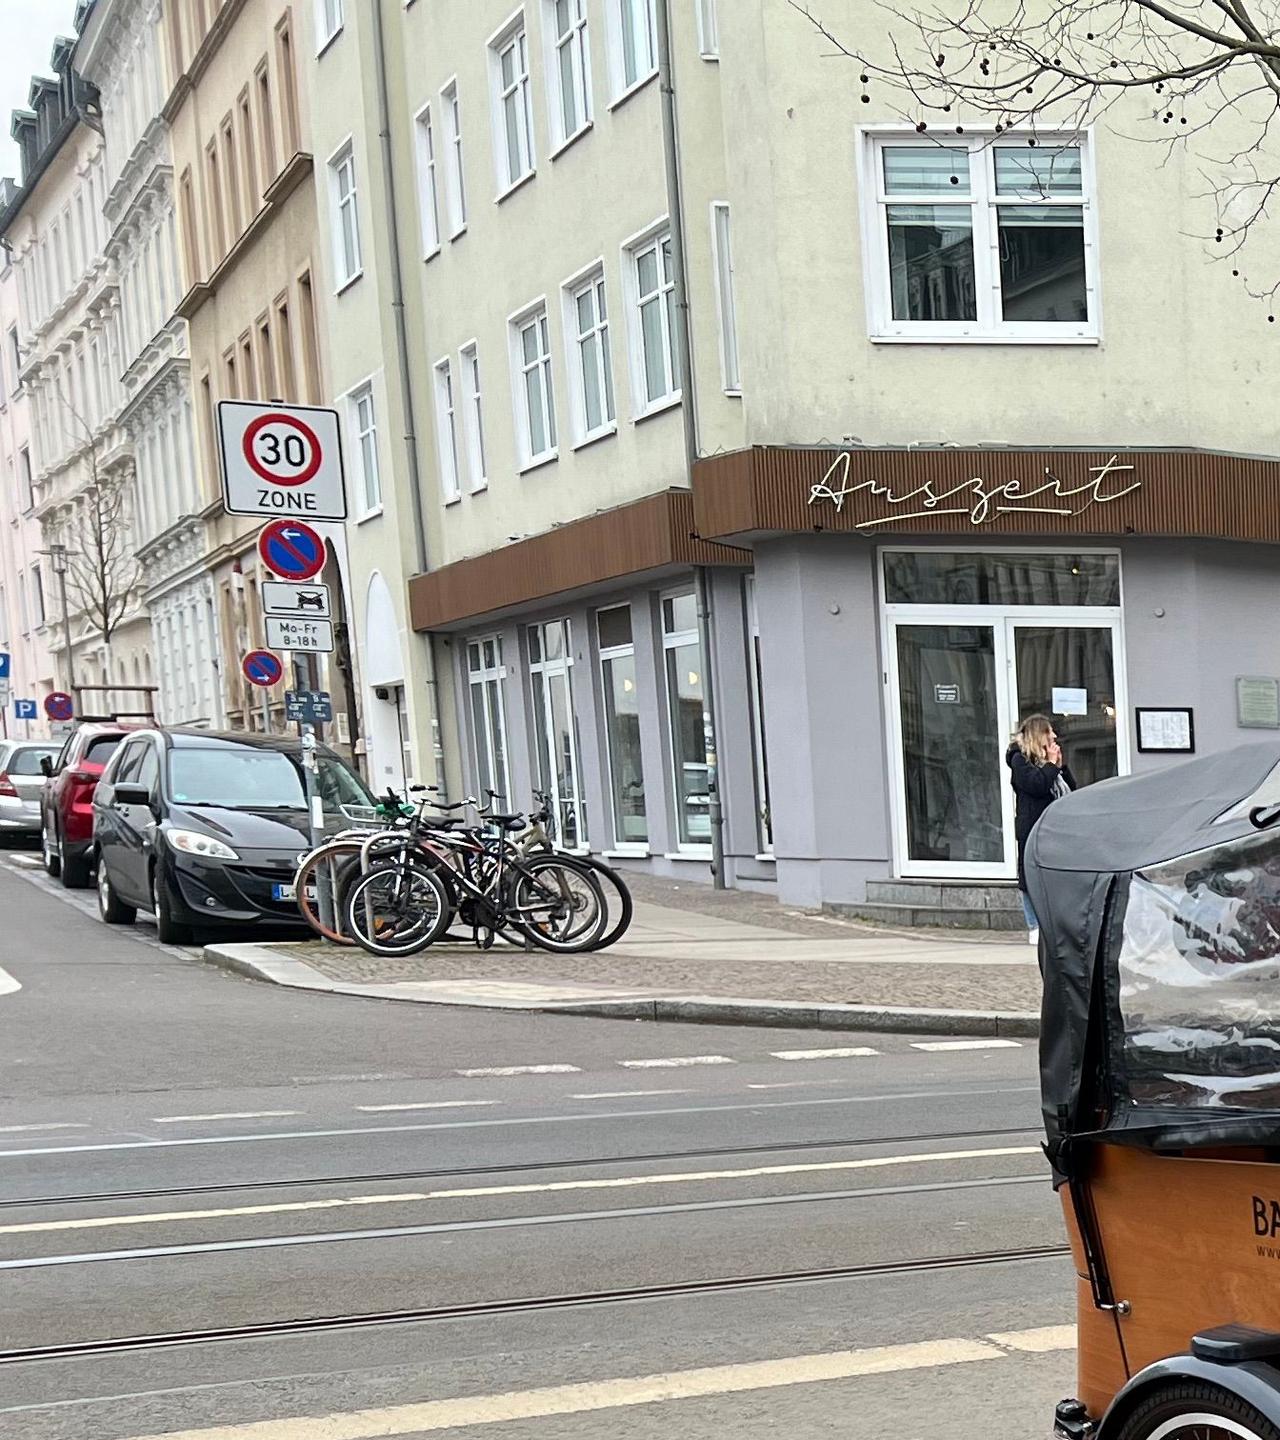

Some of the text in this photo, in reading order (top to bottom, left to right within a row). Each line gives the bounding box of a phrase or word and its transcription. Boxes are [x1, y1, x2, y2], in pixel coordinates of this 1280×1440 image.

[259, 433, 305, 467] 30
[257, 490, 317, 511] ZONE
[808, 452, 1141, 526] Auszeit
[279, 622, 318, 634] Mo-Fr
